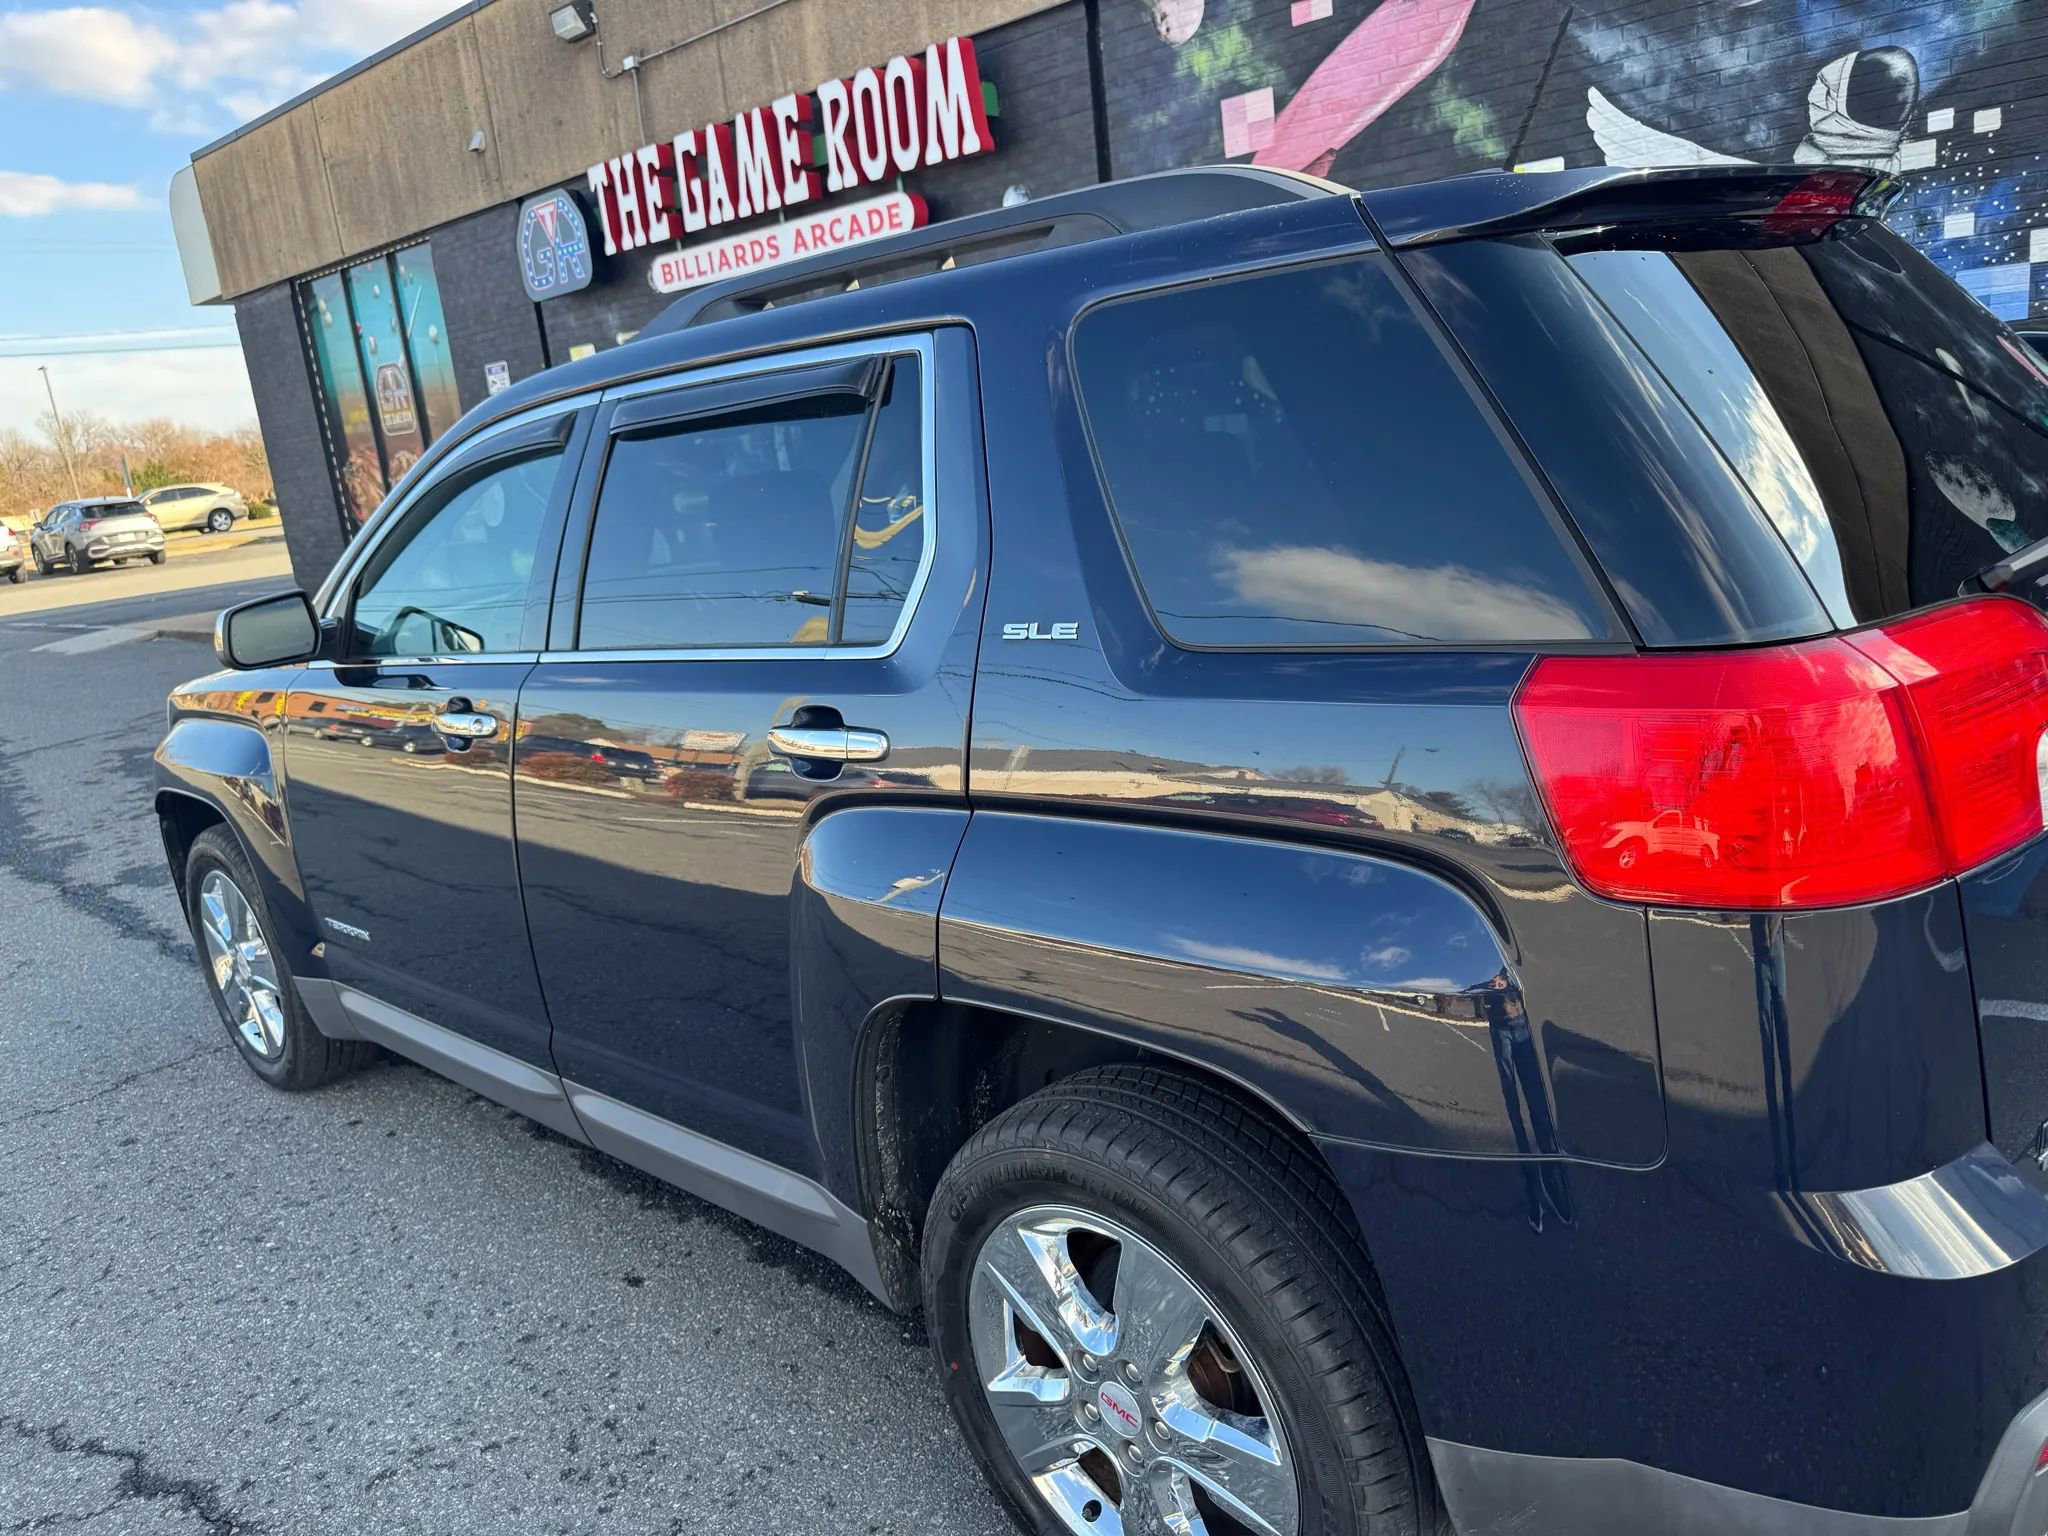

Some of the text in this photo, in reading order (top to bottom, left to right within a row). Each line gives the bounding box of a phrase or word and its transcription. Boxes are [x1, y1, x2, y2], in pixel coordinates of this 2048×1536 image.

[587, 36, 982, 257] THE GAME ROOM
[660, 202, 904, 287] BILLIARDS ARCADE
[1002, 622, 1079, 640] SLE
[1101, 1392, 1138, 1428] GMC
